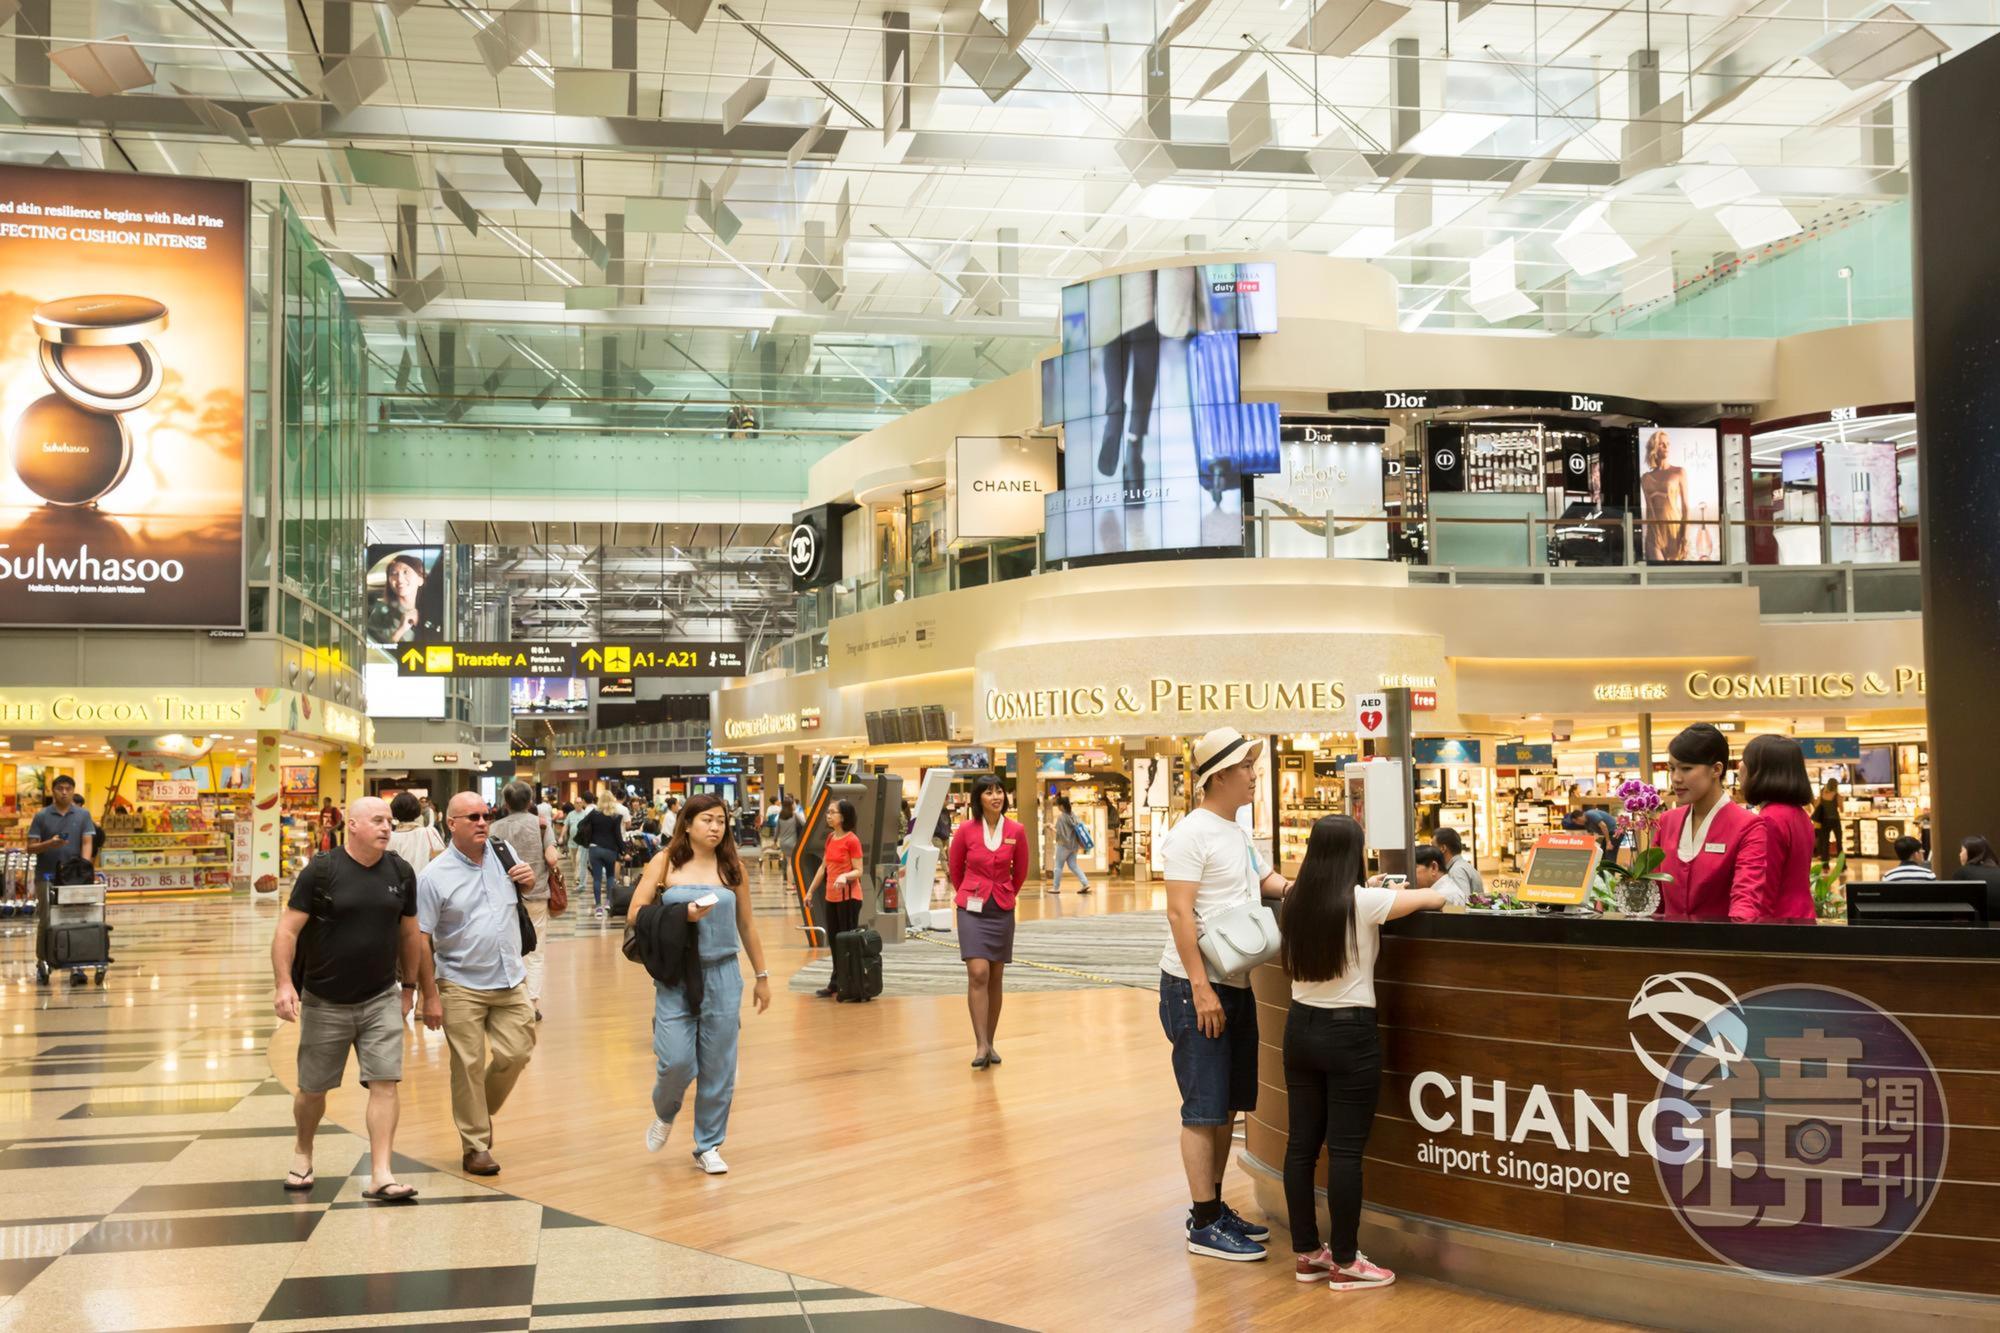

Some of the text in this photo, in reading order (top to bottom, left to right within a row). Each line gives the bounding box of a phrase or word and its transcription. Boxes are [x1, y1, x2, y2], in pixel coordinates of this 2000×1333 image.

[16, 202, 42, 215] skin
[44, 205, 101, 219] resilience
[103, 208, 142, 223] begins
[144, 212, 170, 224] with
[173, 214, 195, 226] Red
[198, 215, 224, 228] Pine
[70, 227, 140, 245] CUSHION
[144, 232, 207, 249] INTENSE
[1214, 282, 1258, 292] duty free
[1384, 393, 1427, 409] Dior
[1571, 395, 1604, 412] Dior
[1304, 428, 1333, 442] Dior
[42, 442, 90, 453] Sulwhasoo
[973, 480, 1043, 492] CHANEL
[1124, 488, 1170, 499] FLIGHT
[0, 543, 184, 582] Sulwhasoo
[55, 585, 79, 594] Beauty
[80, 585, 97, 593] from
[208, 630, 245, 638] JCDecaux
[455, 653, 527, 667] Transfer A
[1687, 671, 1855, 699] COSMETICS
[1864, 672, 1890, 696] &
[986, 678, 1346, 721] COSMETICS & PERFUMES
[1361, 698, 1381, 707] AED
[1414, 693, 1435, 706] free
[53, 697, 148, 720] COCOA
[157, 697, 241, 720] TREES
[1409, 1070, 1733, 1169] CHANGI
[1417, 1138, 1631, 1195] airport singapore
